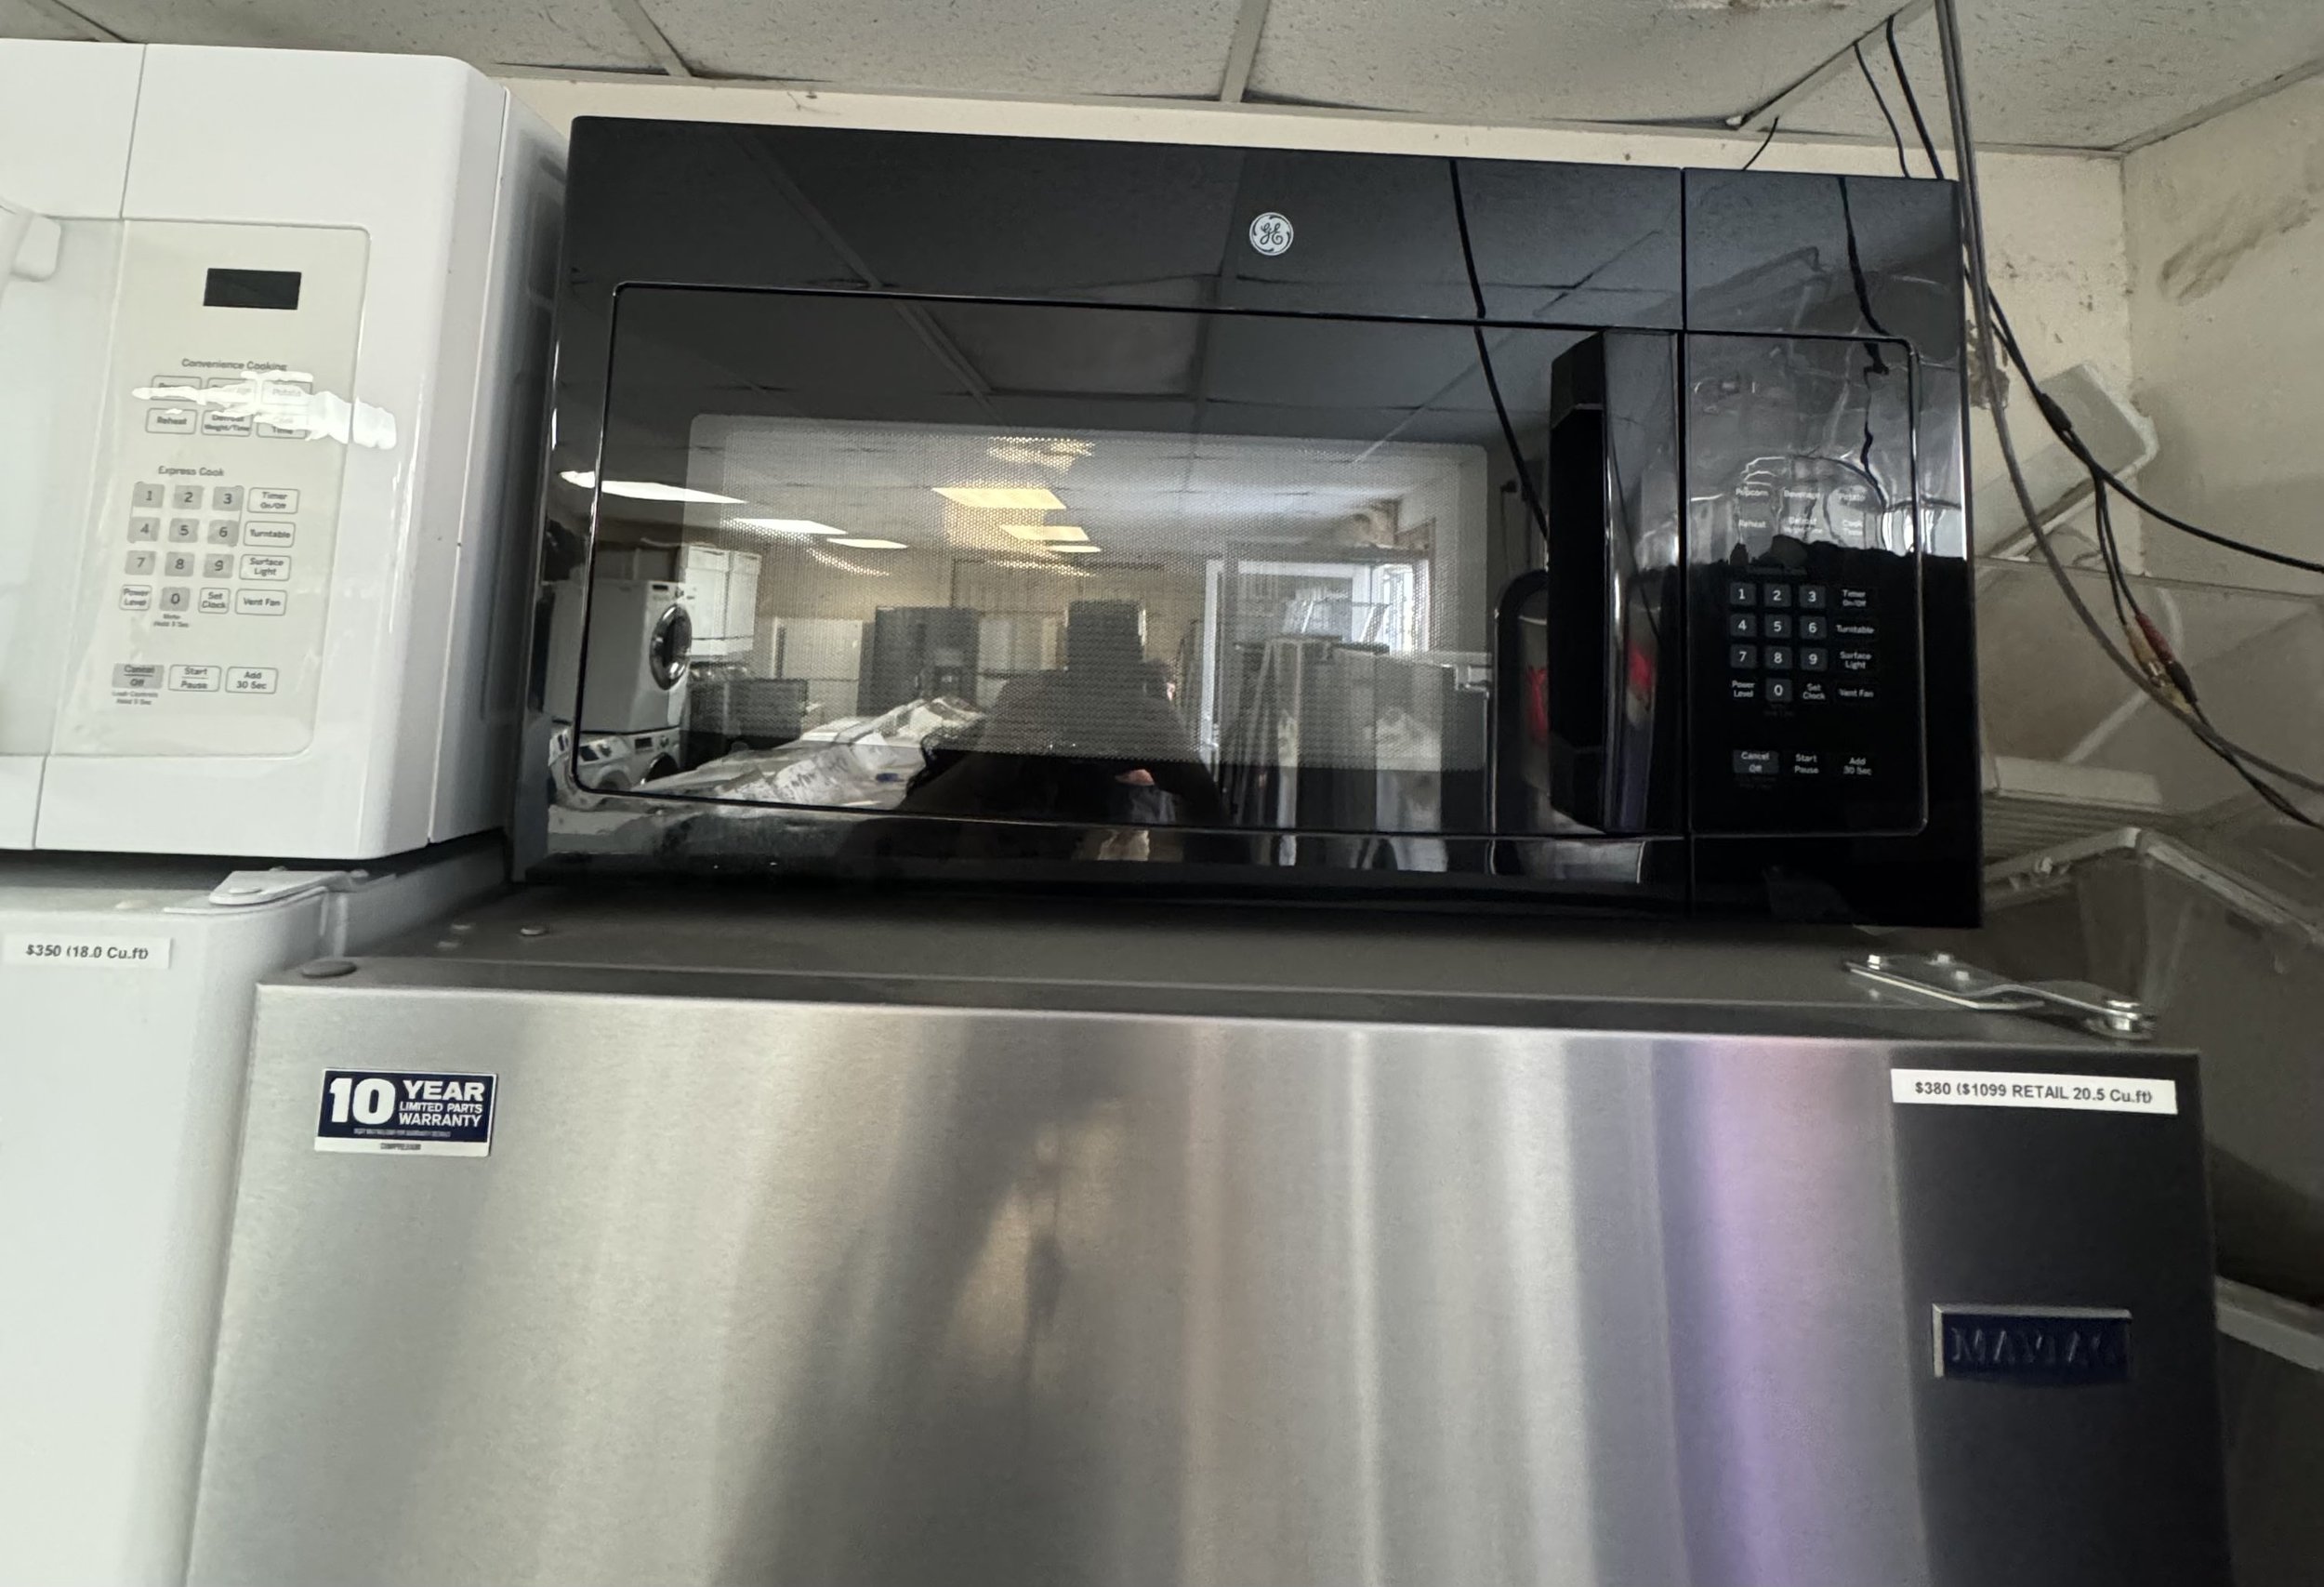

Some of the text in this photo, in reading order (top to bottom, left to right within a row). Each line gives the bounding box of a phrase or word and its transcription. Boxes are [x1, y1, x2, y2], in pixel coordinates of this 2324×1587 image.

[181, 358, 287, 372] Convenience Cooking
[157, 416, 188, 426] Reheat
[158, 466, 225, 477] Express Cook
[146, 490, 152, 502] 1
[184, 492, 193, 503] 2
[223, 494, 232, 505] 3
[262, 491, 288, 500] Timer
[139, 523, 150, 535] 4
[179, 524, 190, 536] 5
[218, 526, 228, 537] 6
[249, 529, 291, 539] Turntable
[137, 557, 146, 568] 7
[175, 558, 185, 570] 8
[214, 560, 224, 572] 9
[249, 557, 284, 567] Surface
[254, 567, 277, 577] Light
[124, 588, 150, 597] Power
[207, 591, 223, 600] Set
[1737, 588, 1746, 601] 1
[1772, 589, 1782, 602] 2
[1808, 590, 1816, 602] 3
[1842, 589, 1867, 598] Timer
[170, 592, 180, 605] 0
[243, 597, 281, 606] Vent Fan
[202, 601, 226, 609] Clock
[1737, 618, 1747, 631] 4
[1773, 620, 1782, 632] 5
[1808, 622, 1817, 634] 6
[1835, 624, 1875, 635] Turntable
[1738, 651, 1748, 663] 7
[1774, 652, 1783, 664] 8
[1808, 653, 1818, 666] 9
[1840, 651, 1872, 661] Surface
[124, 664, 155, 674] Cancel
[1844, 660, 1867, 670] Light
[184, 667, 208, 676] Start
[244, 670, 262, 680] Add
[129, 678, 145, 688] Off
[180, 681, 208, 690] Pause
[236, 681, 267, 690] 30 Sec
[1731, 680, 1756, 689] Power
[1806, 682, 1822, 692] Set
[1733, 689, 1754, 698] Level
[1773, 684, 1783, 696] 0
[1802, 691, 1826, 700] Clock
[1839, 688, 1875, 698] Vent Fan
[1740, 750, 1770, 761] Cancel
[1795, 753, 1818, 763] Start
[1848, 757, 1867, 766] Add
[1794, 765, 1819, 774] Pause
[1842, 766, 1872, 775] 30 Sec
[25, 944, 150, 960] $350 (18.0 Cu.ft)
[402, 1079, 486, 1102] YEAR
[1914, 1081, 2153, 1104] $380 ($1099 RETAIL 20.5 Cu.ft)
[329, 1078, 396, 1125] 10
[399, 1101, 483, 1115] LIMITED PARTS
[398, 1112, 482, 1128] WARRANTY
